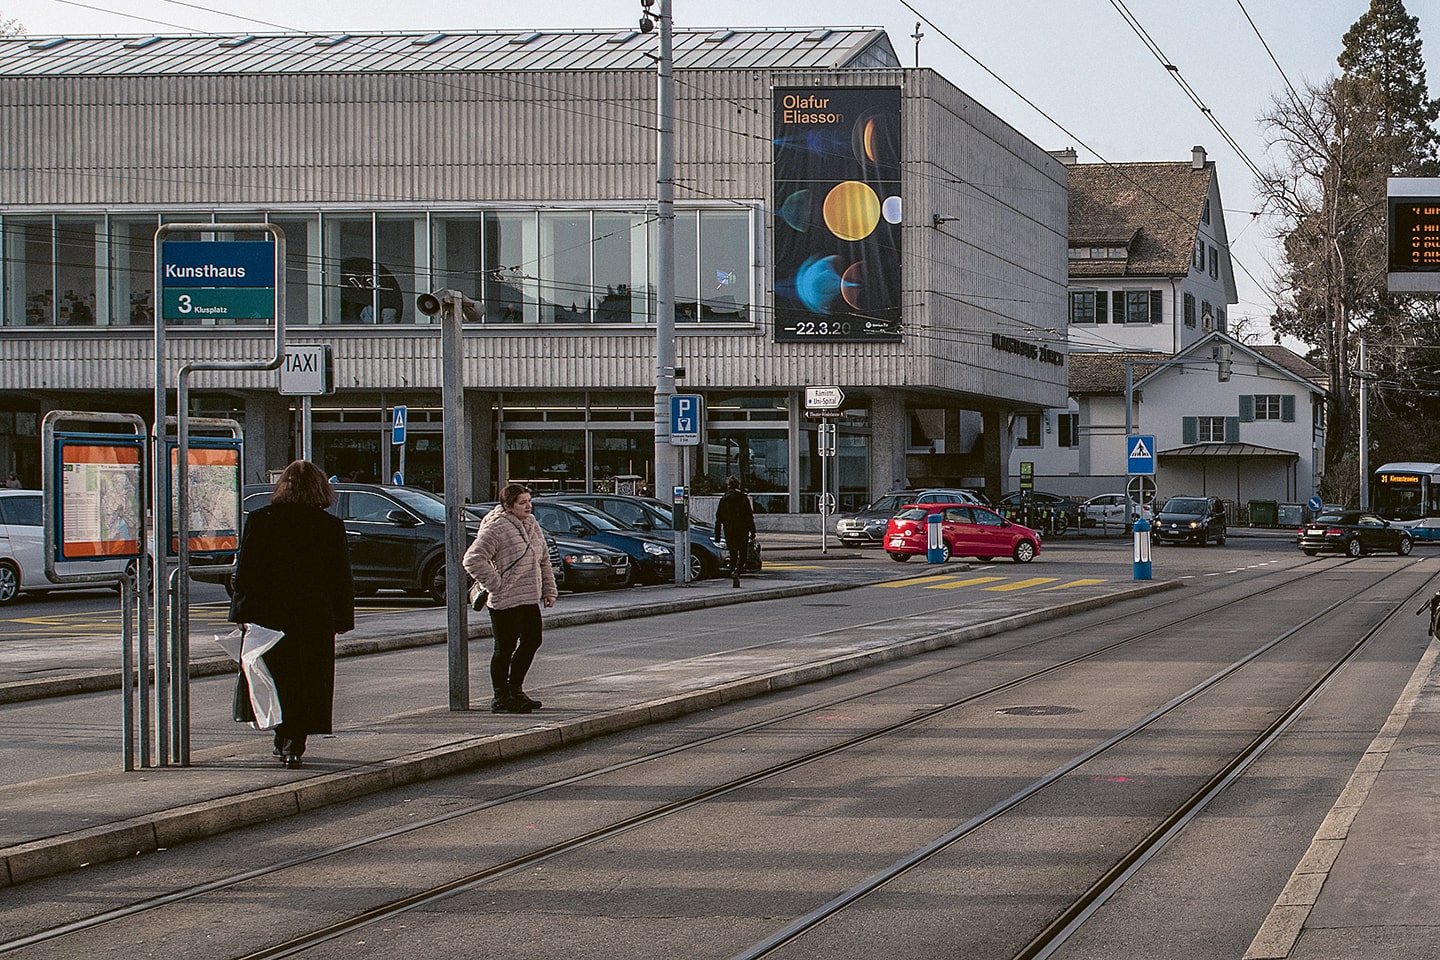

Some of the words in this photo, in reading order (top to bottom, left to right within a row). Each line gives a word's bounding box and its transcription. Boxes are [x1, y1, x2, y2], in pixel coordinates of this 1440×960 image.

[783, 95, 829, 109] Olafur
[783, 110, 845, 124] Eliasson
[165, 264, 246, 278] Kunsthaus
[178, 295, 192, 314] 3
[194, 306, 228, 314] Klusplatz
[285, 353, 317, 373] TAXI
[679, 399, 690, 417] P
